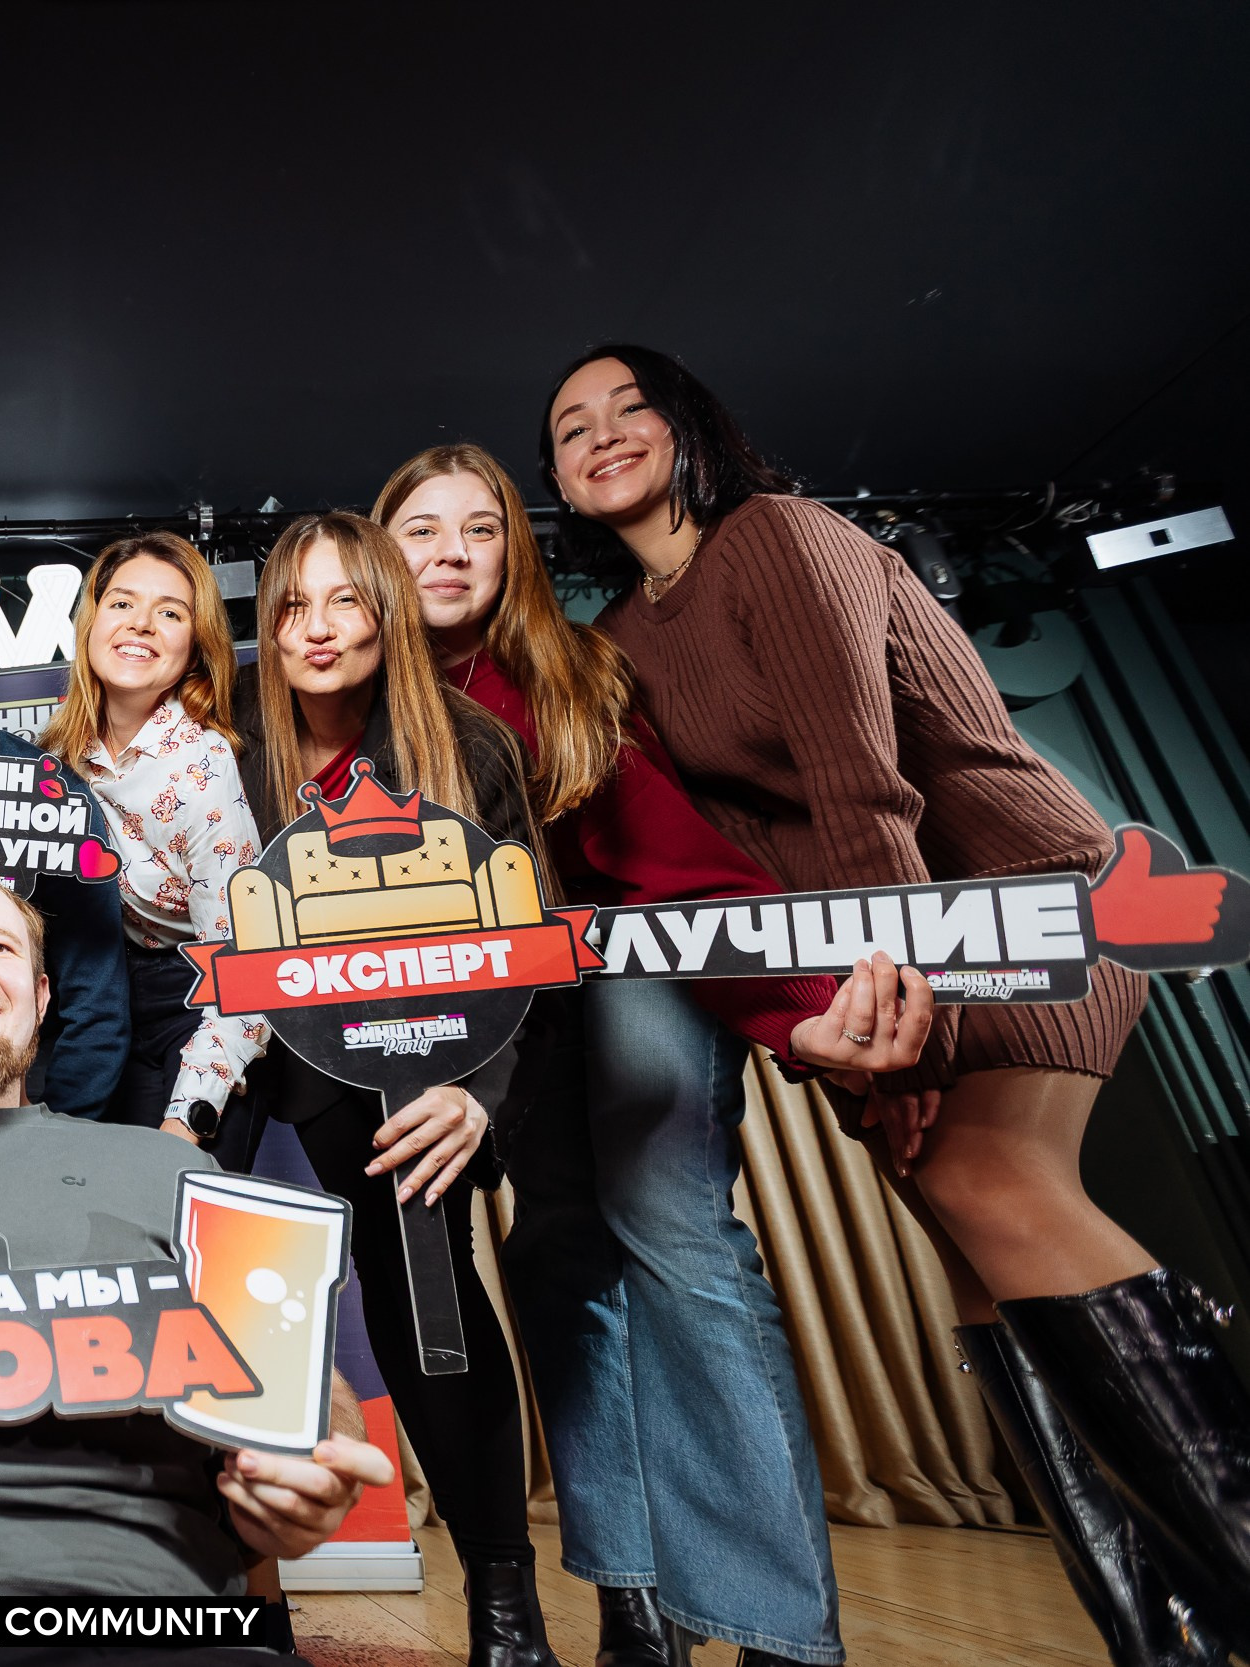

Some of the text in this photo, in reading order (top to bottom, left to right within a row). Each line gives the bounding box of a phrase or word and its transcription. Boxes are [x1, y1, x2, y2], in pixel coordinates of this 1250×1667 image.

[584, 882, 1086, 974] ЛУЧШИЕ
[276, 939, 512, 998] ЭКСПЕРТ
[926, 968, 1051, 988] ЭЙНШТЕЙН
[963, 984, 1015, 1000] Party
[342, 1015, 468, 1045] ЭЙНШТЕЙН
[382, 1036, 434, 1057] Party
[34, 1266, 140, 1311] МЫ
